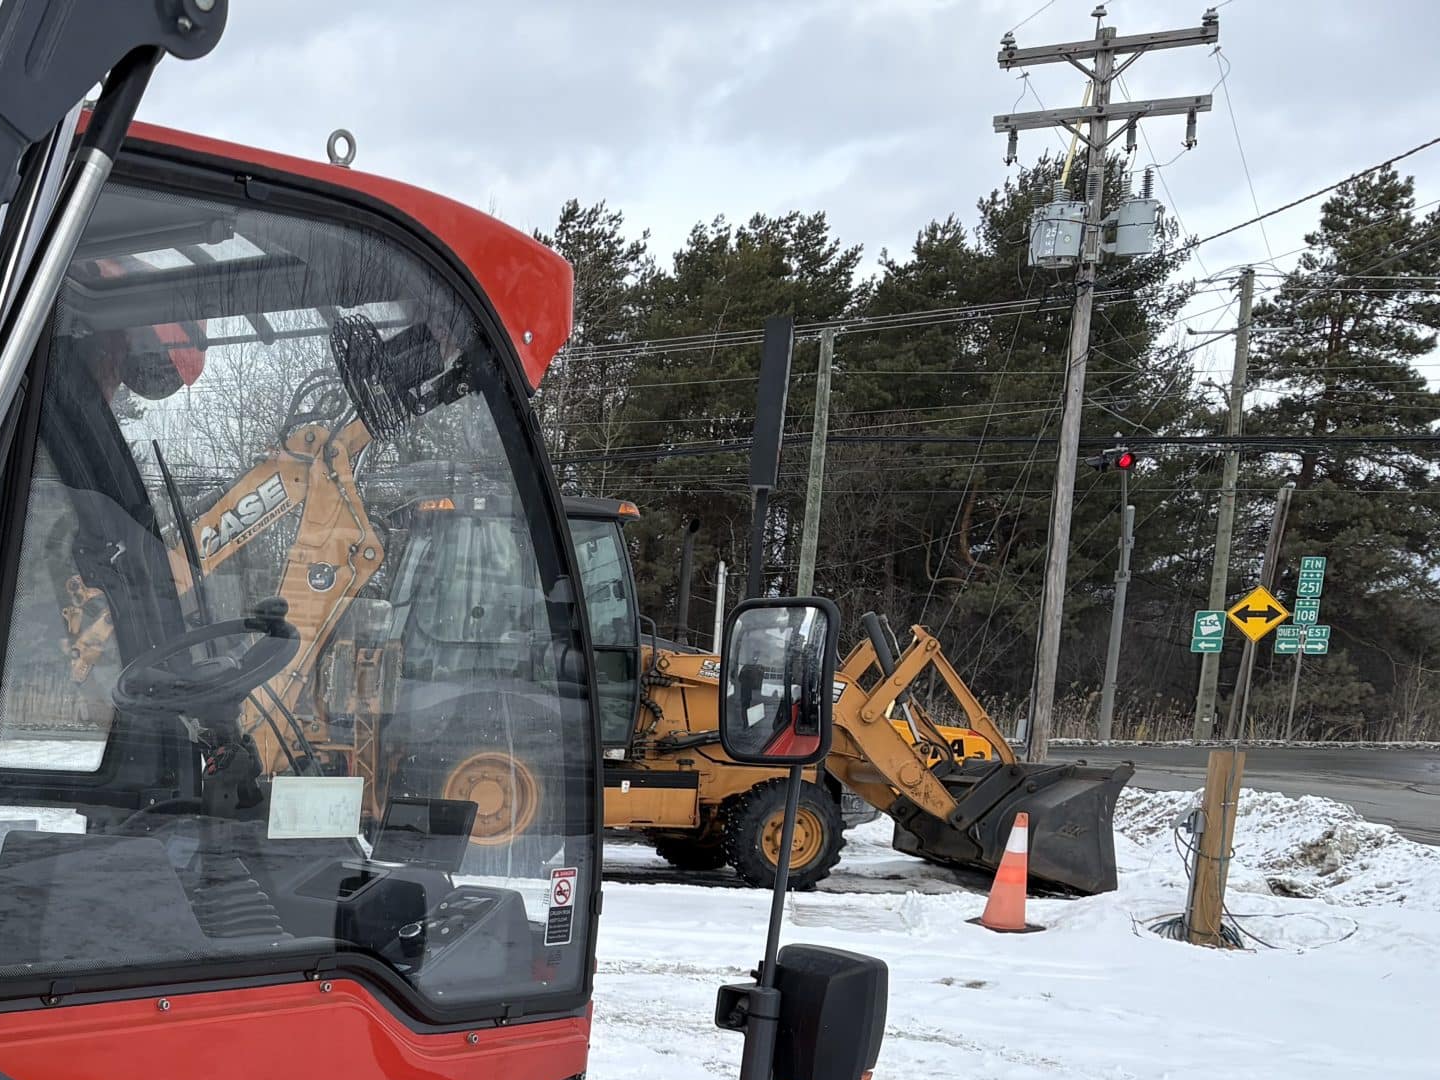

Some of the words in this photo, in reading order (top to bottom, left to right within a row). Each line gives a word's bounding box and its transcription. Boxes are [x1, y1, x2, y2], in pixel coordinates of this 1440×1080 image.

[1304, 559, 1322, 569] FIN
[1300, 582, 1320, 593] 251
[1296, 610, 1316, 621] 108
[1278, 628, 1299, 637] OUEST
[1308, 628, 1327, 637] EST
